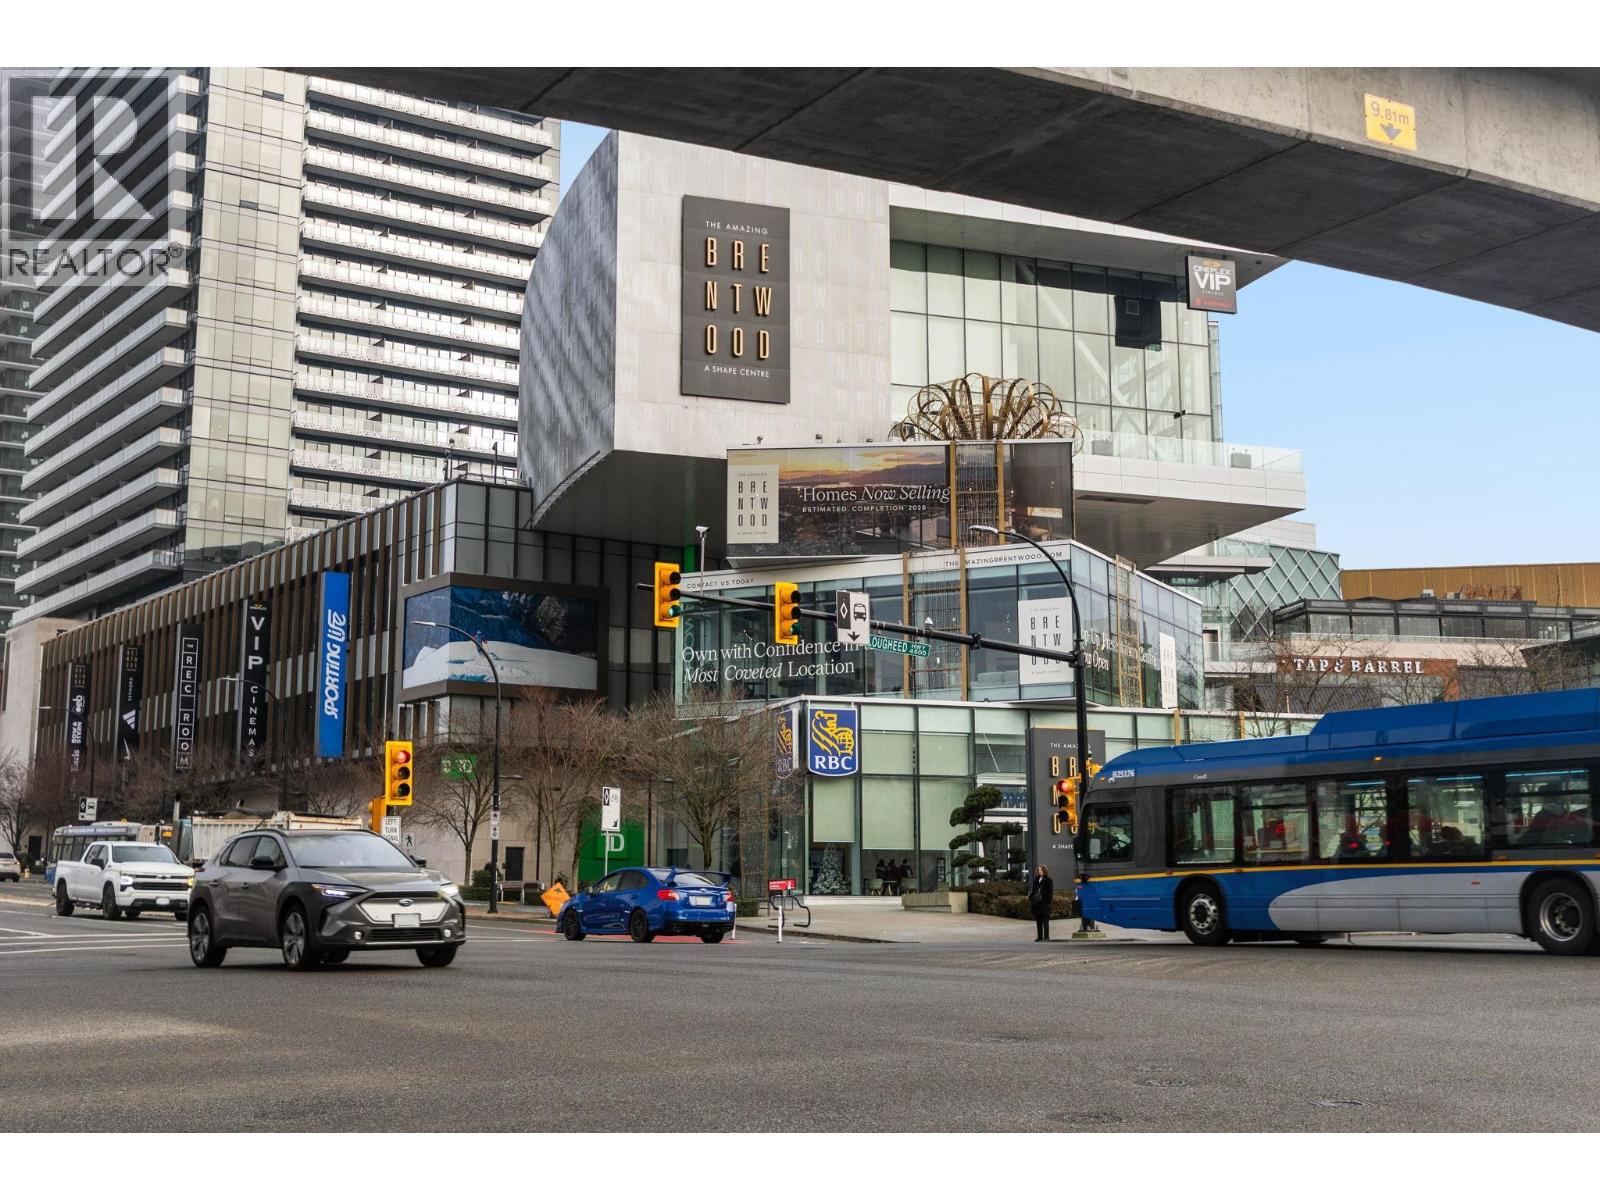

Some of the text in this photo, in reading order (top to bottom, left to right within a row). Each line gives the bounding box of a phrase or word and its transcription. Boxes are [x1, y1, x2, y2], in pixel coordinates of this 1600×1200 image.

[1370, 100, 1409, 126] 9.81m
[706, 220, 769, 235] THE AMAZING
[1193, 265, 1231, 276] CINEPLEX
[1194, 271, 1232, 291] VIP
[704, 365, 770, 378] A SHAPE CENTRE
[803, 485, 951, 504] Homes Now Selling
[851, 505, 904, 513] COMPLETION
[908, 504, 927, 512] 2028
[945, 551, 1063, 567] THEMAZINGBRENTWOOD.OM
[732, 578, 754, 586] TODAY
[248, 616, 265, 670] VIP
[682, 646, 718, 663] Own
[721, 643, 751, 660] with
[754, 638, 840, 658] Confidence
[1093, 650, 1109, 672] Open
[1293, 658, 1425, 674] TAP & BARREL
[683, 659, 856, 684] Most Coveted Location
[777, 757, 792, 773] RBC
[814, 755, 853, 770] RBC
[385, 818, 397, 826] LEFT
